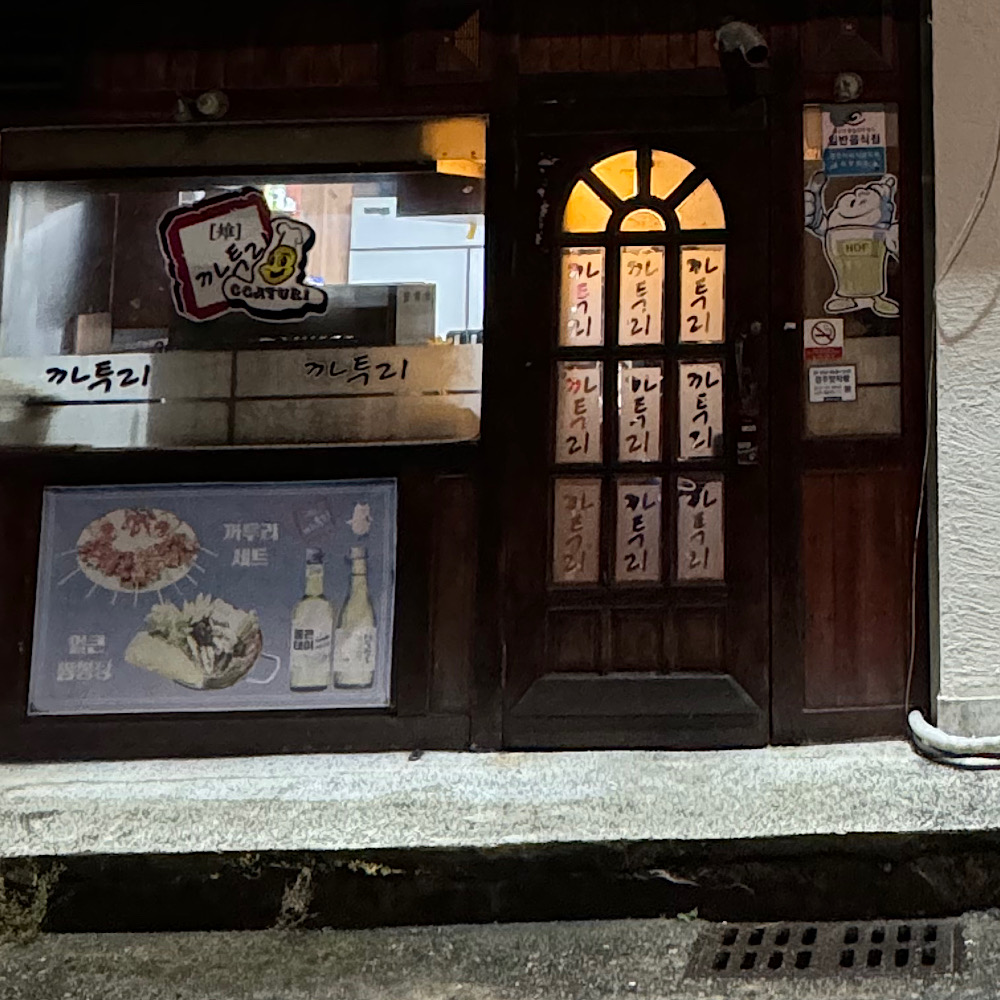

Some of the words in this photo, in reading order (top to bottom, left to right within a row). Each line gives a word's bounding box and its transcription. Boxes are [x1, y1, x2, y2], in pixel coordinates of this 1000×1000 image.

[46, 360, 150, 392] 까투리
[305, 354, 408, 385] 까투리
[687, 371, 719, 449] 까투리
